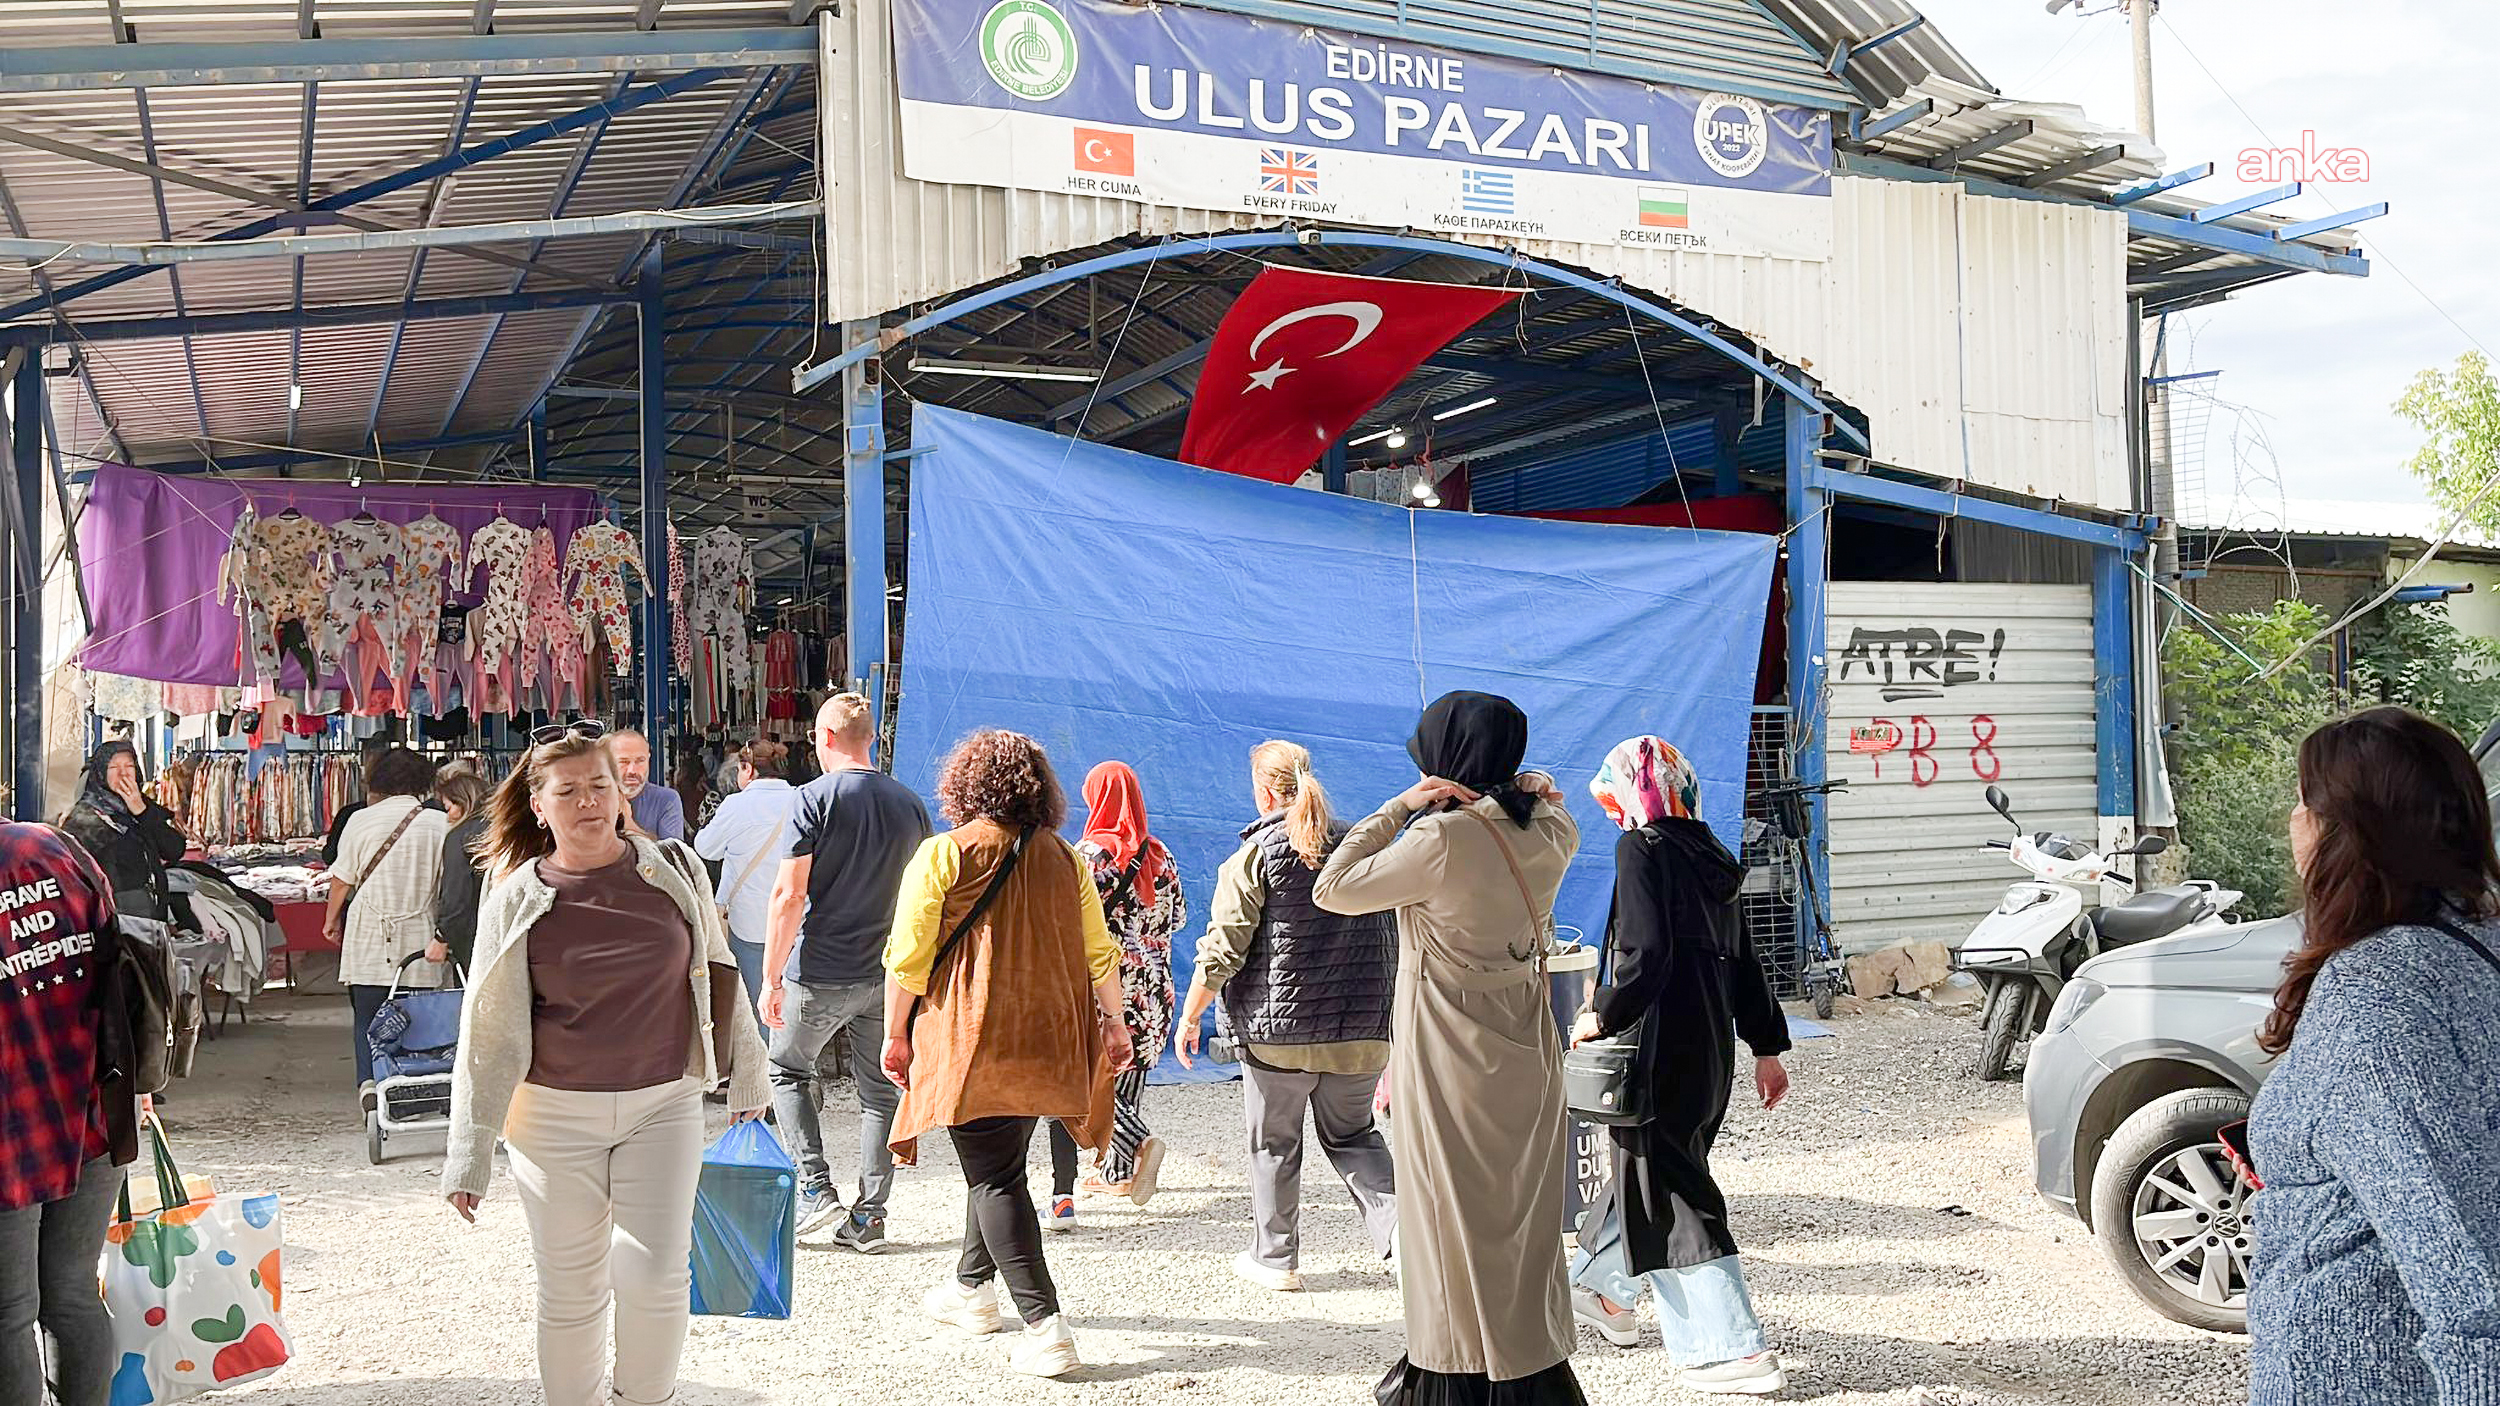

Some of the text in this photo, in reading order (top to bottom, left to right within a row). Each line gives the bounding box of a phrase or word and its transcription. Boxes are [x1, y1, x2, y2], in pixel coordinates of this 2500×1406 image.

[1326, 43, 1465, 94] EDİRNE
[1133, 64, 1651, 173] ULUS PAZARI
[1702, 118, 1761, 147] UPEK
[1721, 143, 1741, 152] 2022
[1067, 176, 1142, 196] HER CUMA
[1243, 194, 1338, 215] EVERY FRIDAY
[1433, 213, 1468, 228] ΚΑΘΕ
[1620, 229, 1707, 248] ВСЕКИ ПЕТЪК
[748, 495, 767, 507] WC
[1968, 714, 2002, 784] 8
[9, 909, 57, 942] AND
[1577, 1179, 1608, 1205] VA
